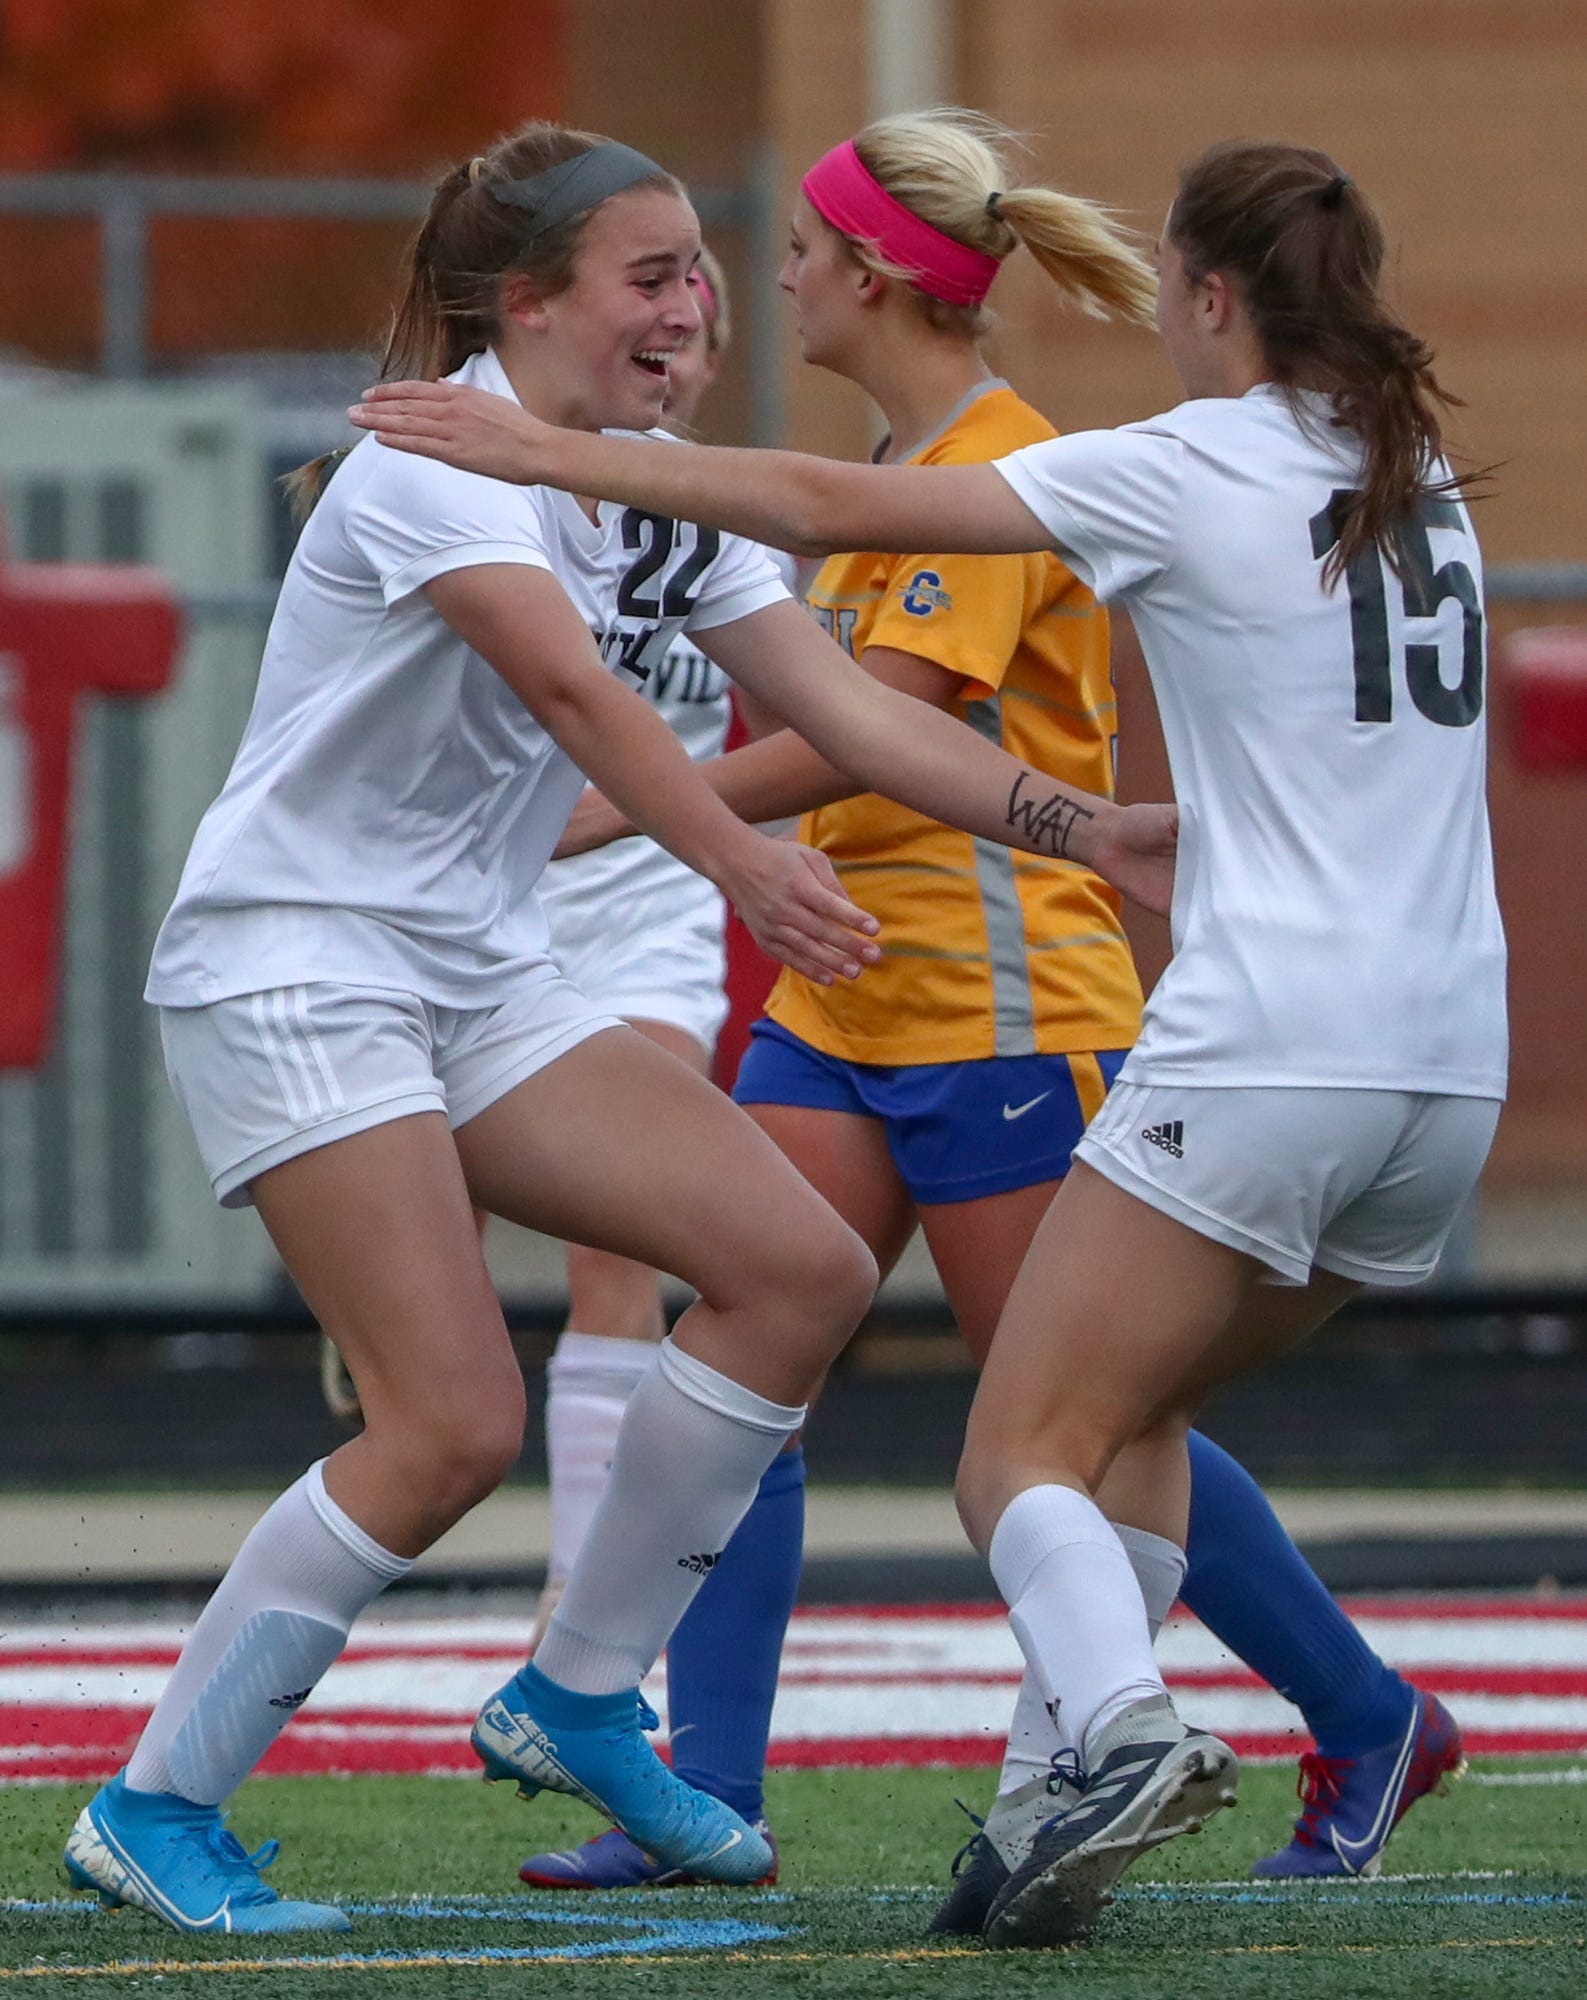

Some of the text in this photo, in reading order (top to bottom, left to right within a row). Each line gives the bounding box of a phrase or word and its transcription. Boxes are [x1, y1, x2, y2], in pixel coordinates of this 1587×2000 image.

[616, 507, 721, 620] 22
[1308, 488, 1483, 728] 15
[1005, 770, 1095, 857] WAT
[1141, 1129, 1184, 1159] adidas
[512, 1712, 559, 1757] MERC
